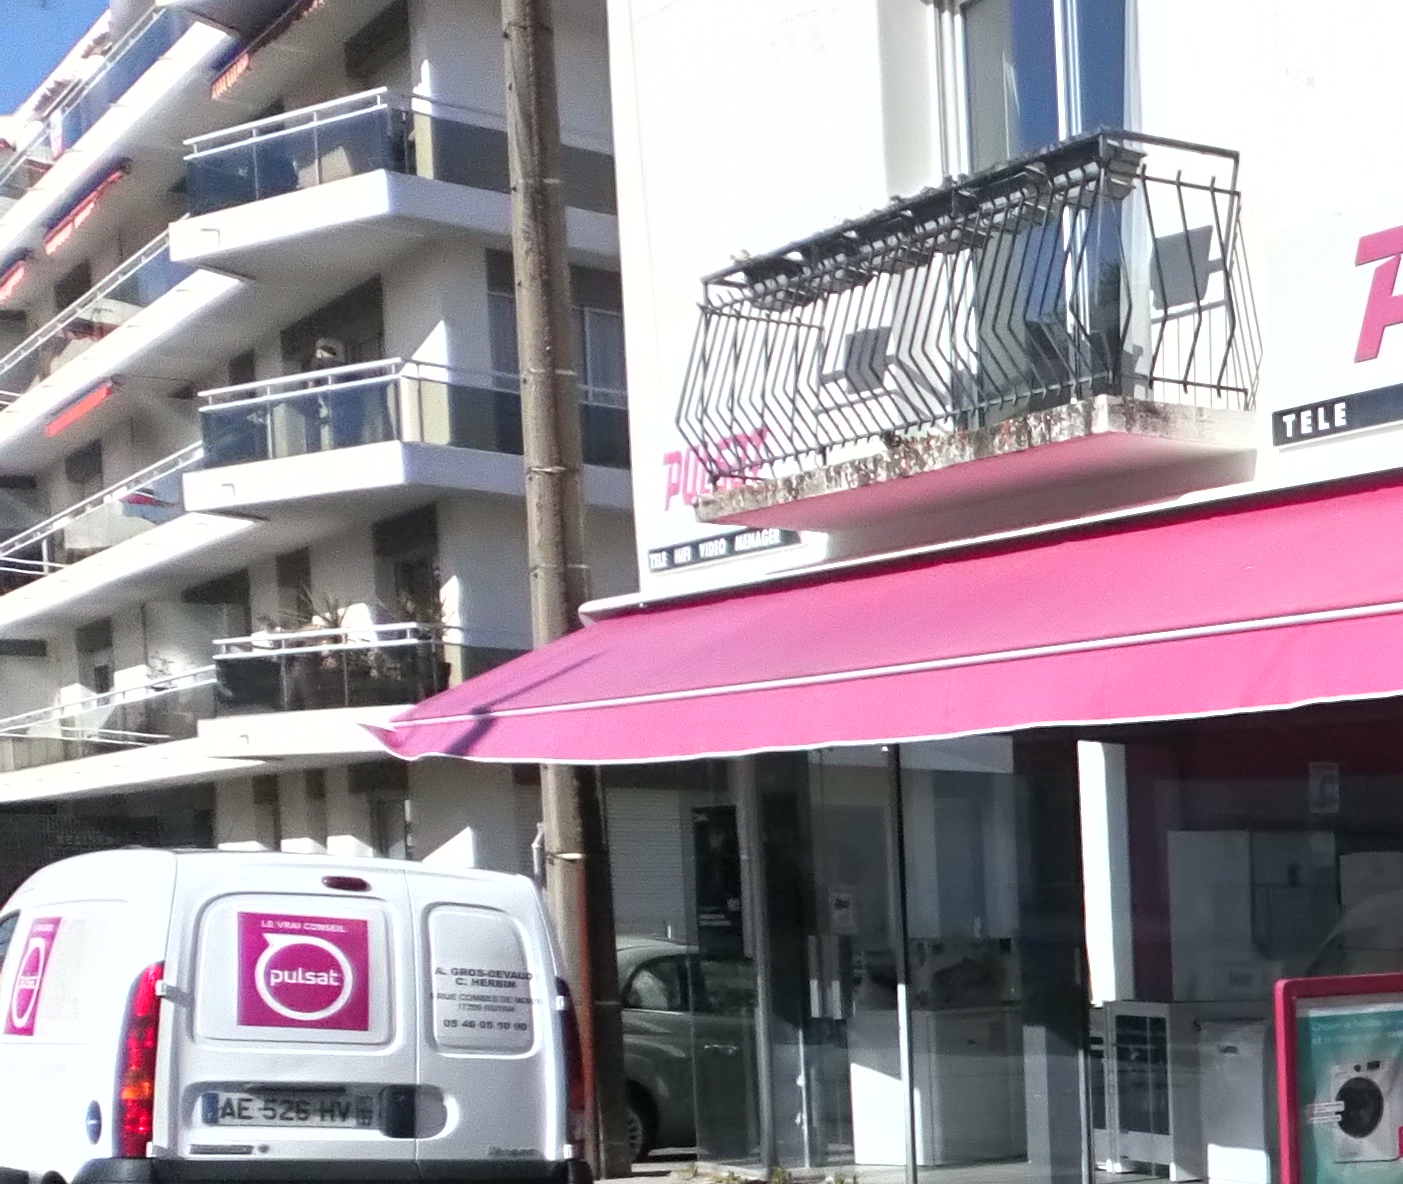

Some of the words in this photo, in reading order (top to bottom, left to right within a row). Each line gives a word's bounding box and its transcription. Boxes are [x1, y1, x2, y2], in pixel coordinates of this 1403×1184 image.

[1282, 402, 1348, 438] TELE
[699, 538, 727, 559] VIDEO
[734, 528, 781, 552] MENAGER
[260, 919, 275, 929] LE
[277, 920, 301, 930] VRAI
[303, 922, 348, 934] CONSEIL
[269, 967, 343, 987] pulsat
